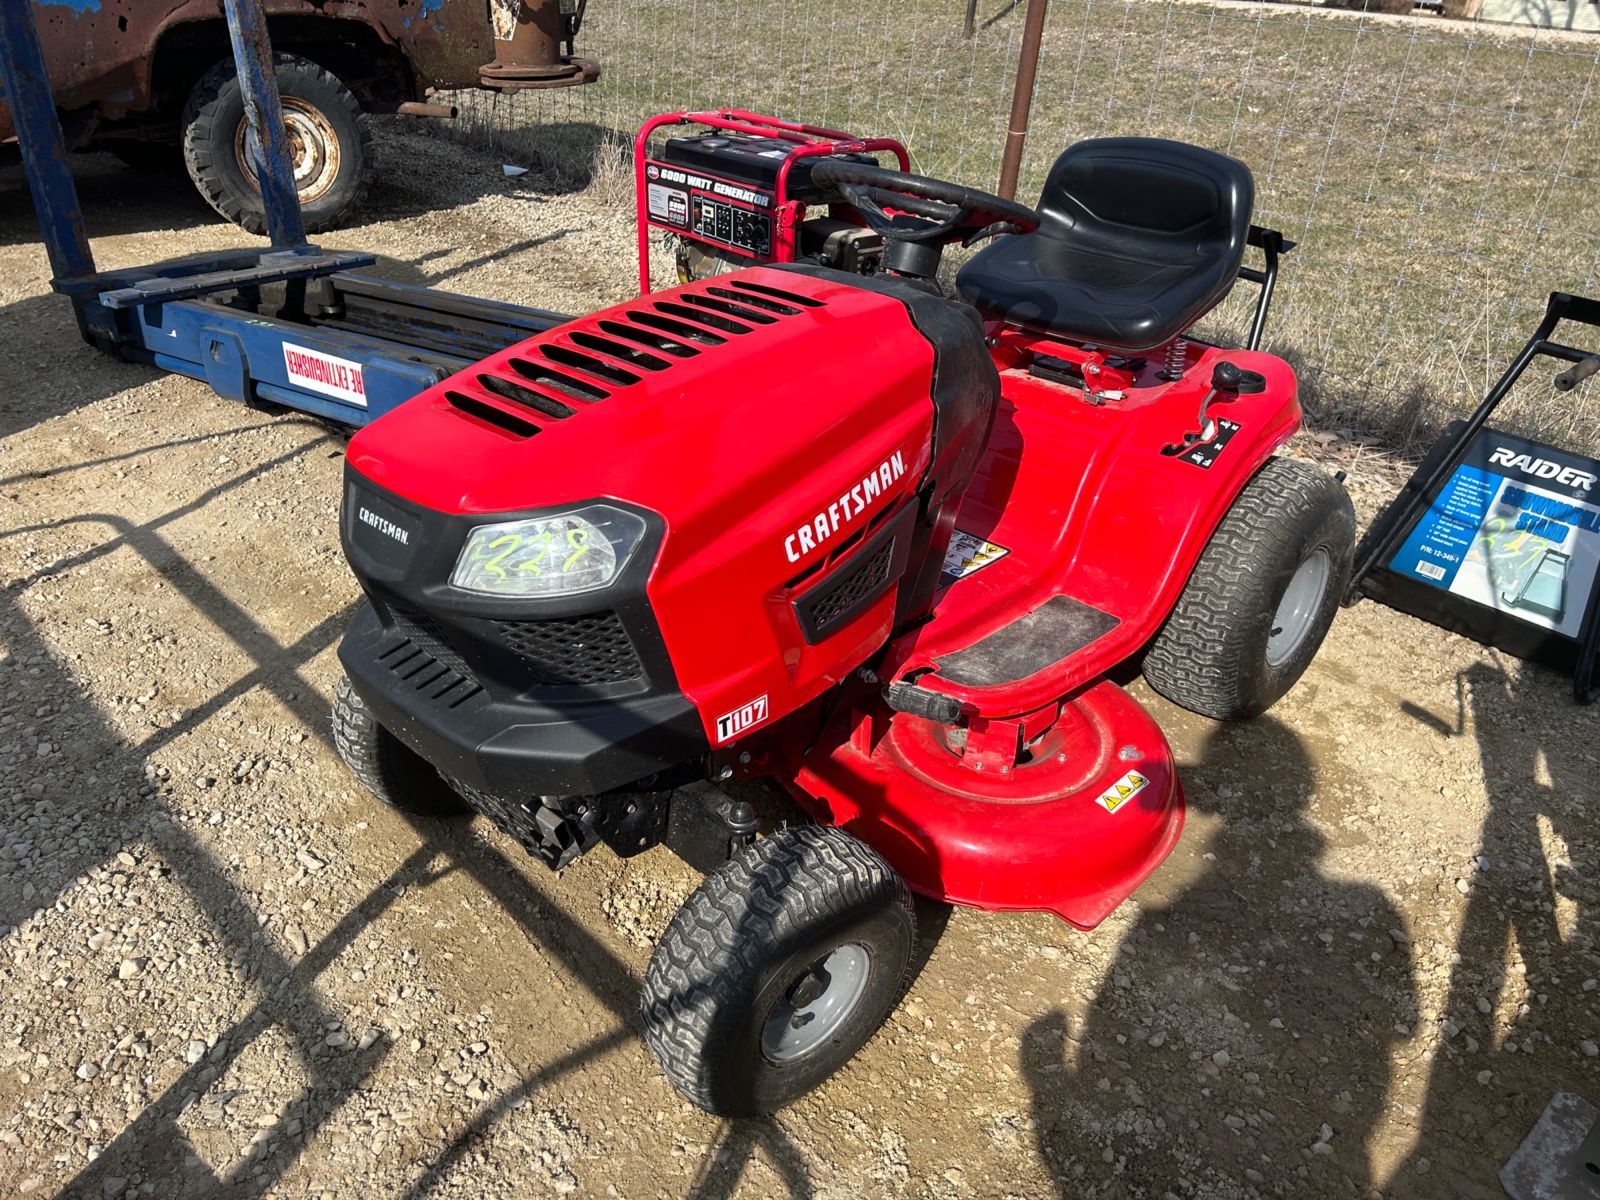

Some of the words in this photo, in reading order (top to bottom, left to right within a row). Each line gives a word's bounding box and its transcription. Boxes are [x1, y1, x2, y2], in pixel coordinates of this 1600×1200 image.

[661, 169, 687, 183] 6000
[687, 176, 713, 190] WATT
[713, 183, 769, 207] GENERATOR
[285, 349, 349, 390] EXTINGUISHER
[1488, 447, 1599, 491] RAIDER
[359, 507, 409, 545] CRAFTSMAN
[784, 450, 905, 563] CRAFTSMAN
[1515, 512, 1570, 544] STAND
[718, 697, 766, 738] T107
